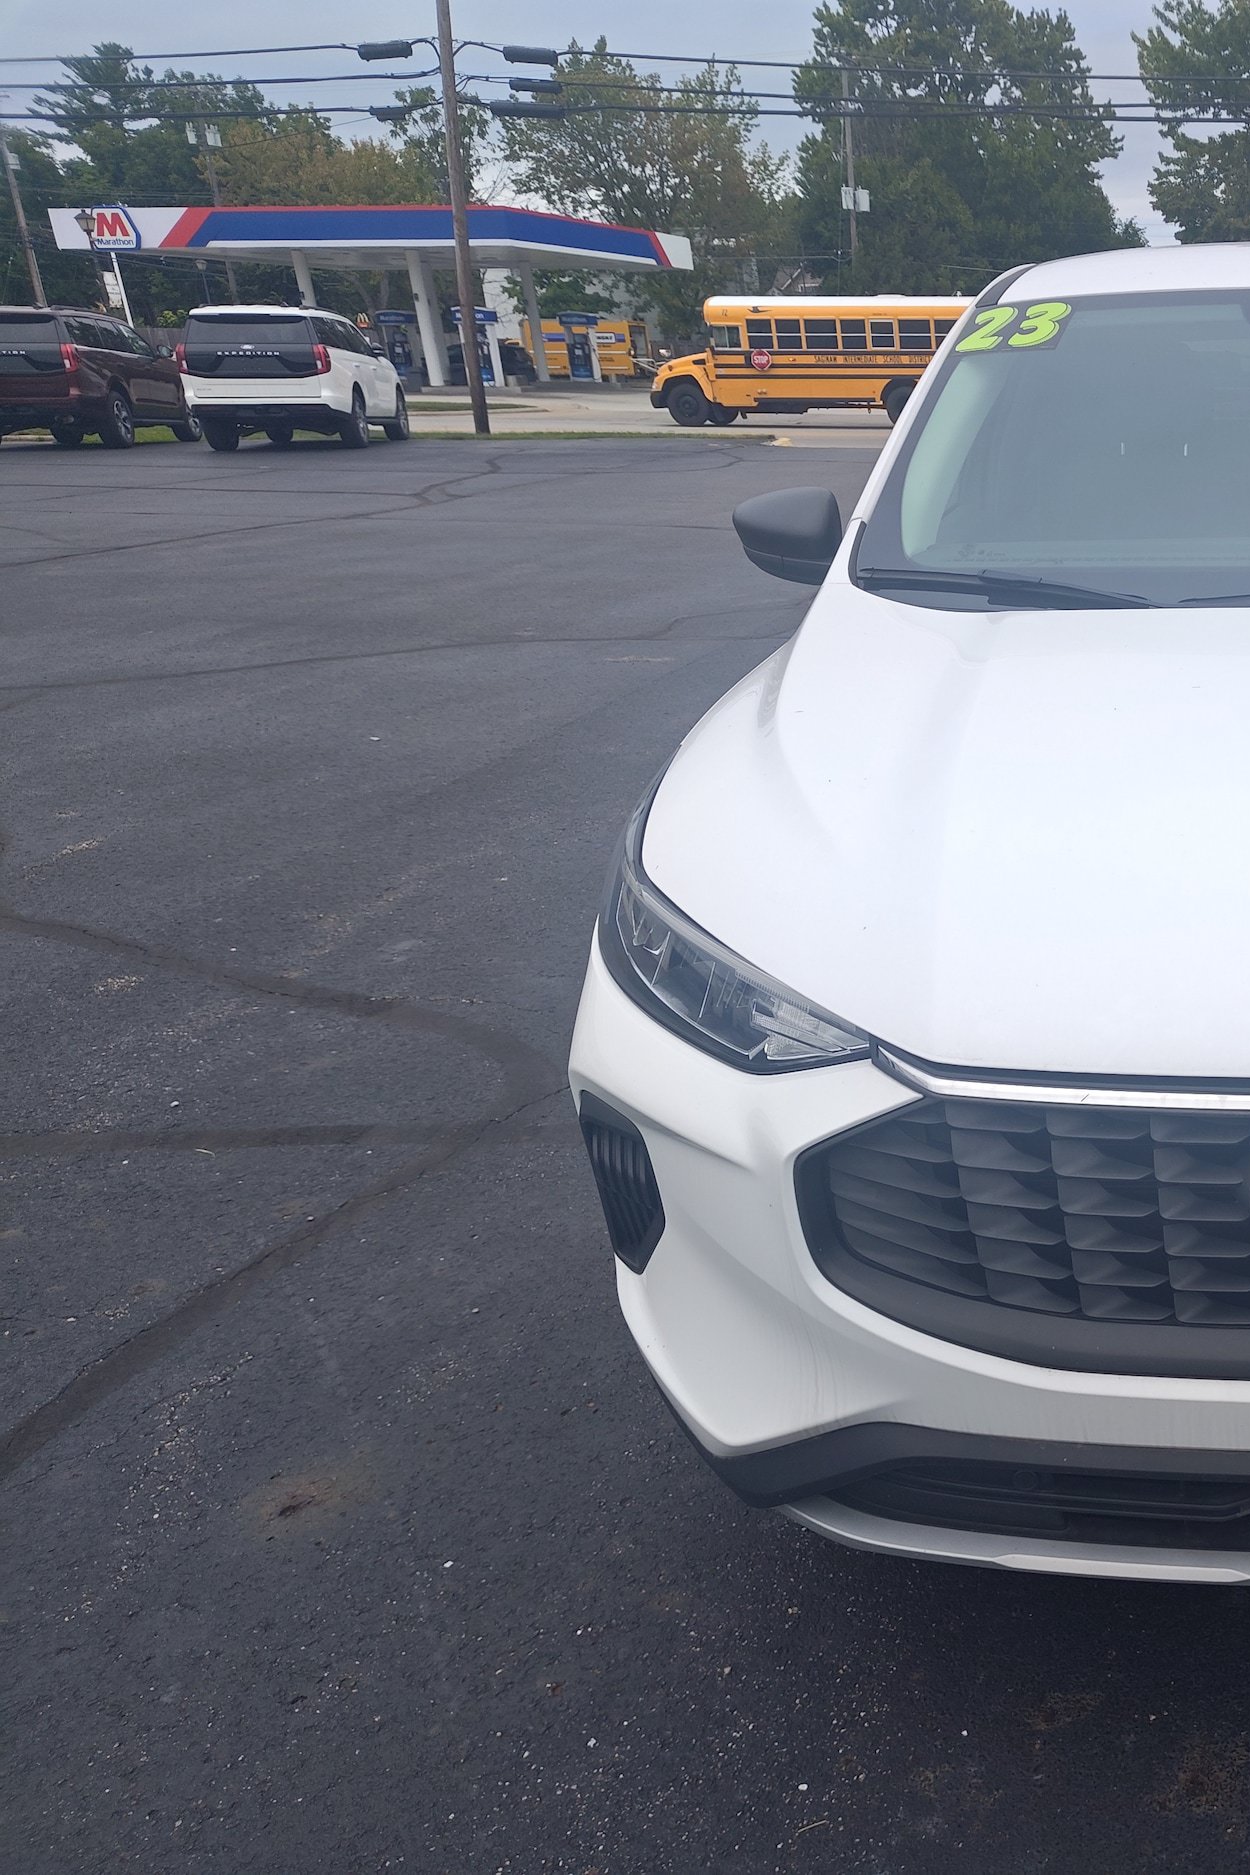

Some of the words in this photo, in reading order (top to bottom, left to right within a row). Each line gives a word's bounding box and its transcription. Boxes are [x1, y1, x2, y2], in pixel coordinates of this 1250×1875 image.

[96, 212, 130, 237] M
[97, 238, 135, 247] Marathon
[955, 302, 1072, 353] 23
[753, 354, 769, 364] STOP
[843, 355, 878, 364] INTERMEDIATE
[883, 355, 903, 364] SCHOOL
